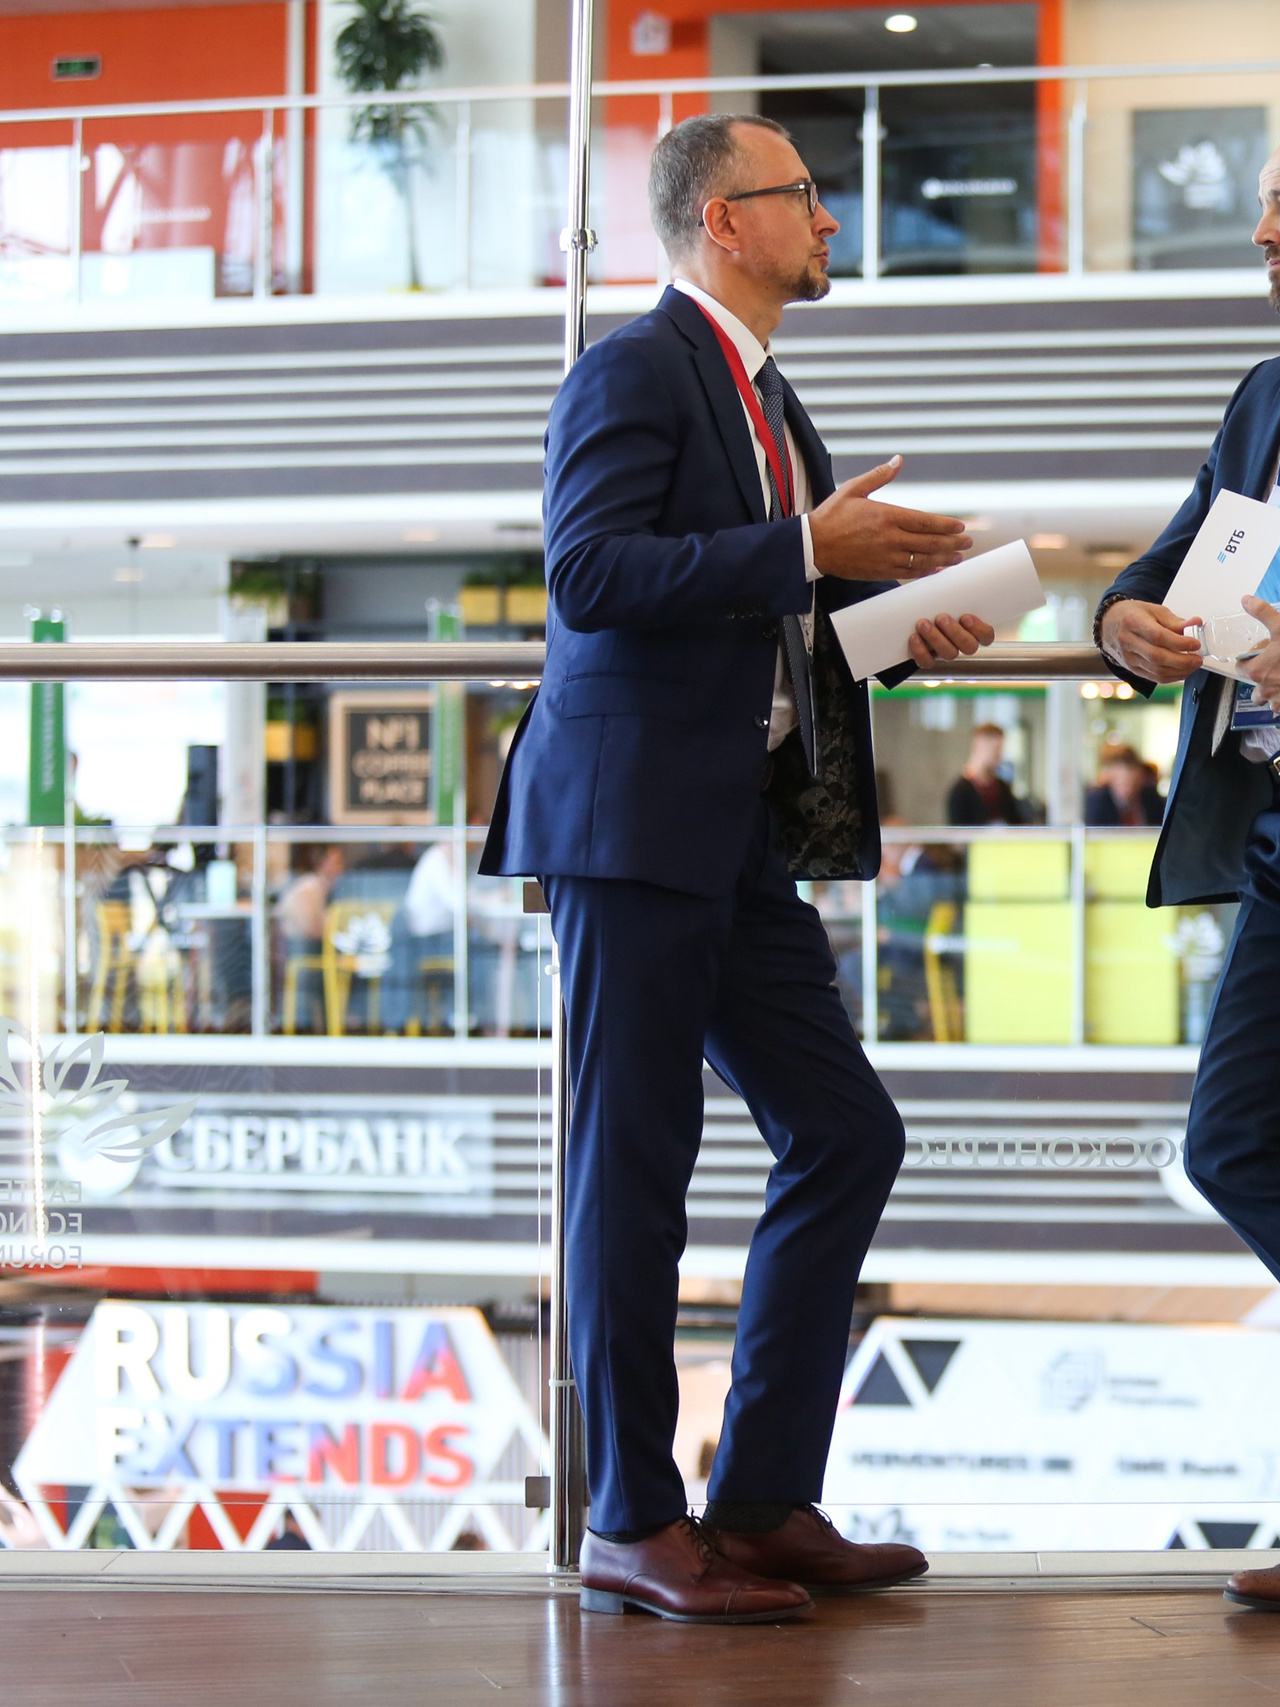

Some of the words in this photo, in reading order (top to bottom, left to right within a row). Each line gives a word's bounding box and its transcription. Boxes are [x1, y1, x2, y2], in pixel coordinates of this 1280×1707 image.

[1224, 529, 1245, 554] ВТБ
[153, 1115, 470, 1177] СБЕРБАНК
[95, 1305, 471, 1403] RUSSIA
[97, 1406, 475, 1489] EXTENDS
